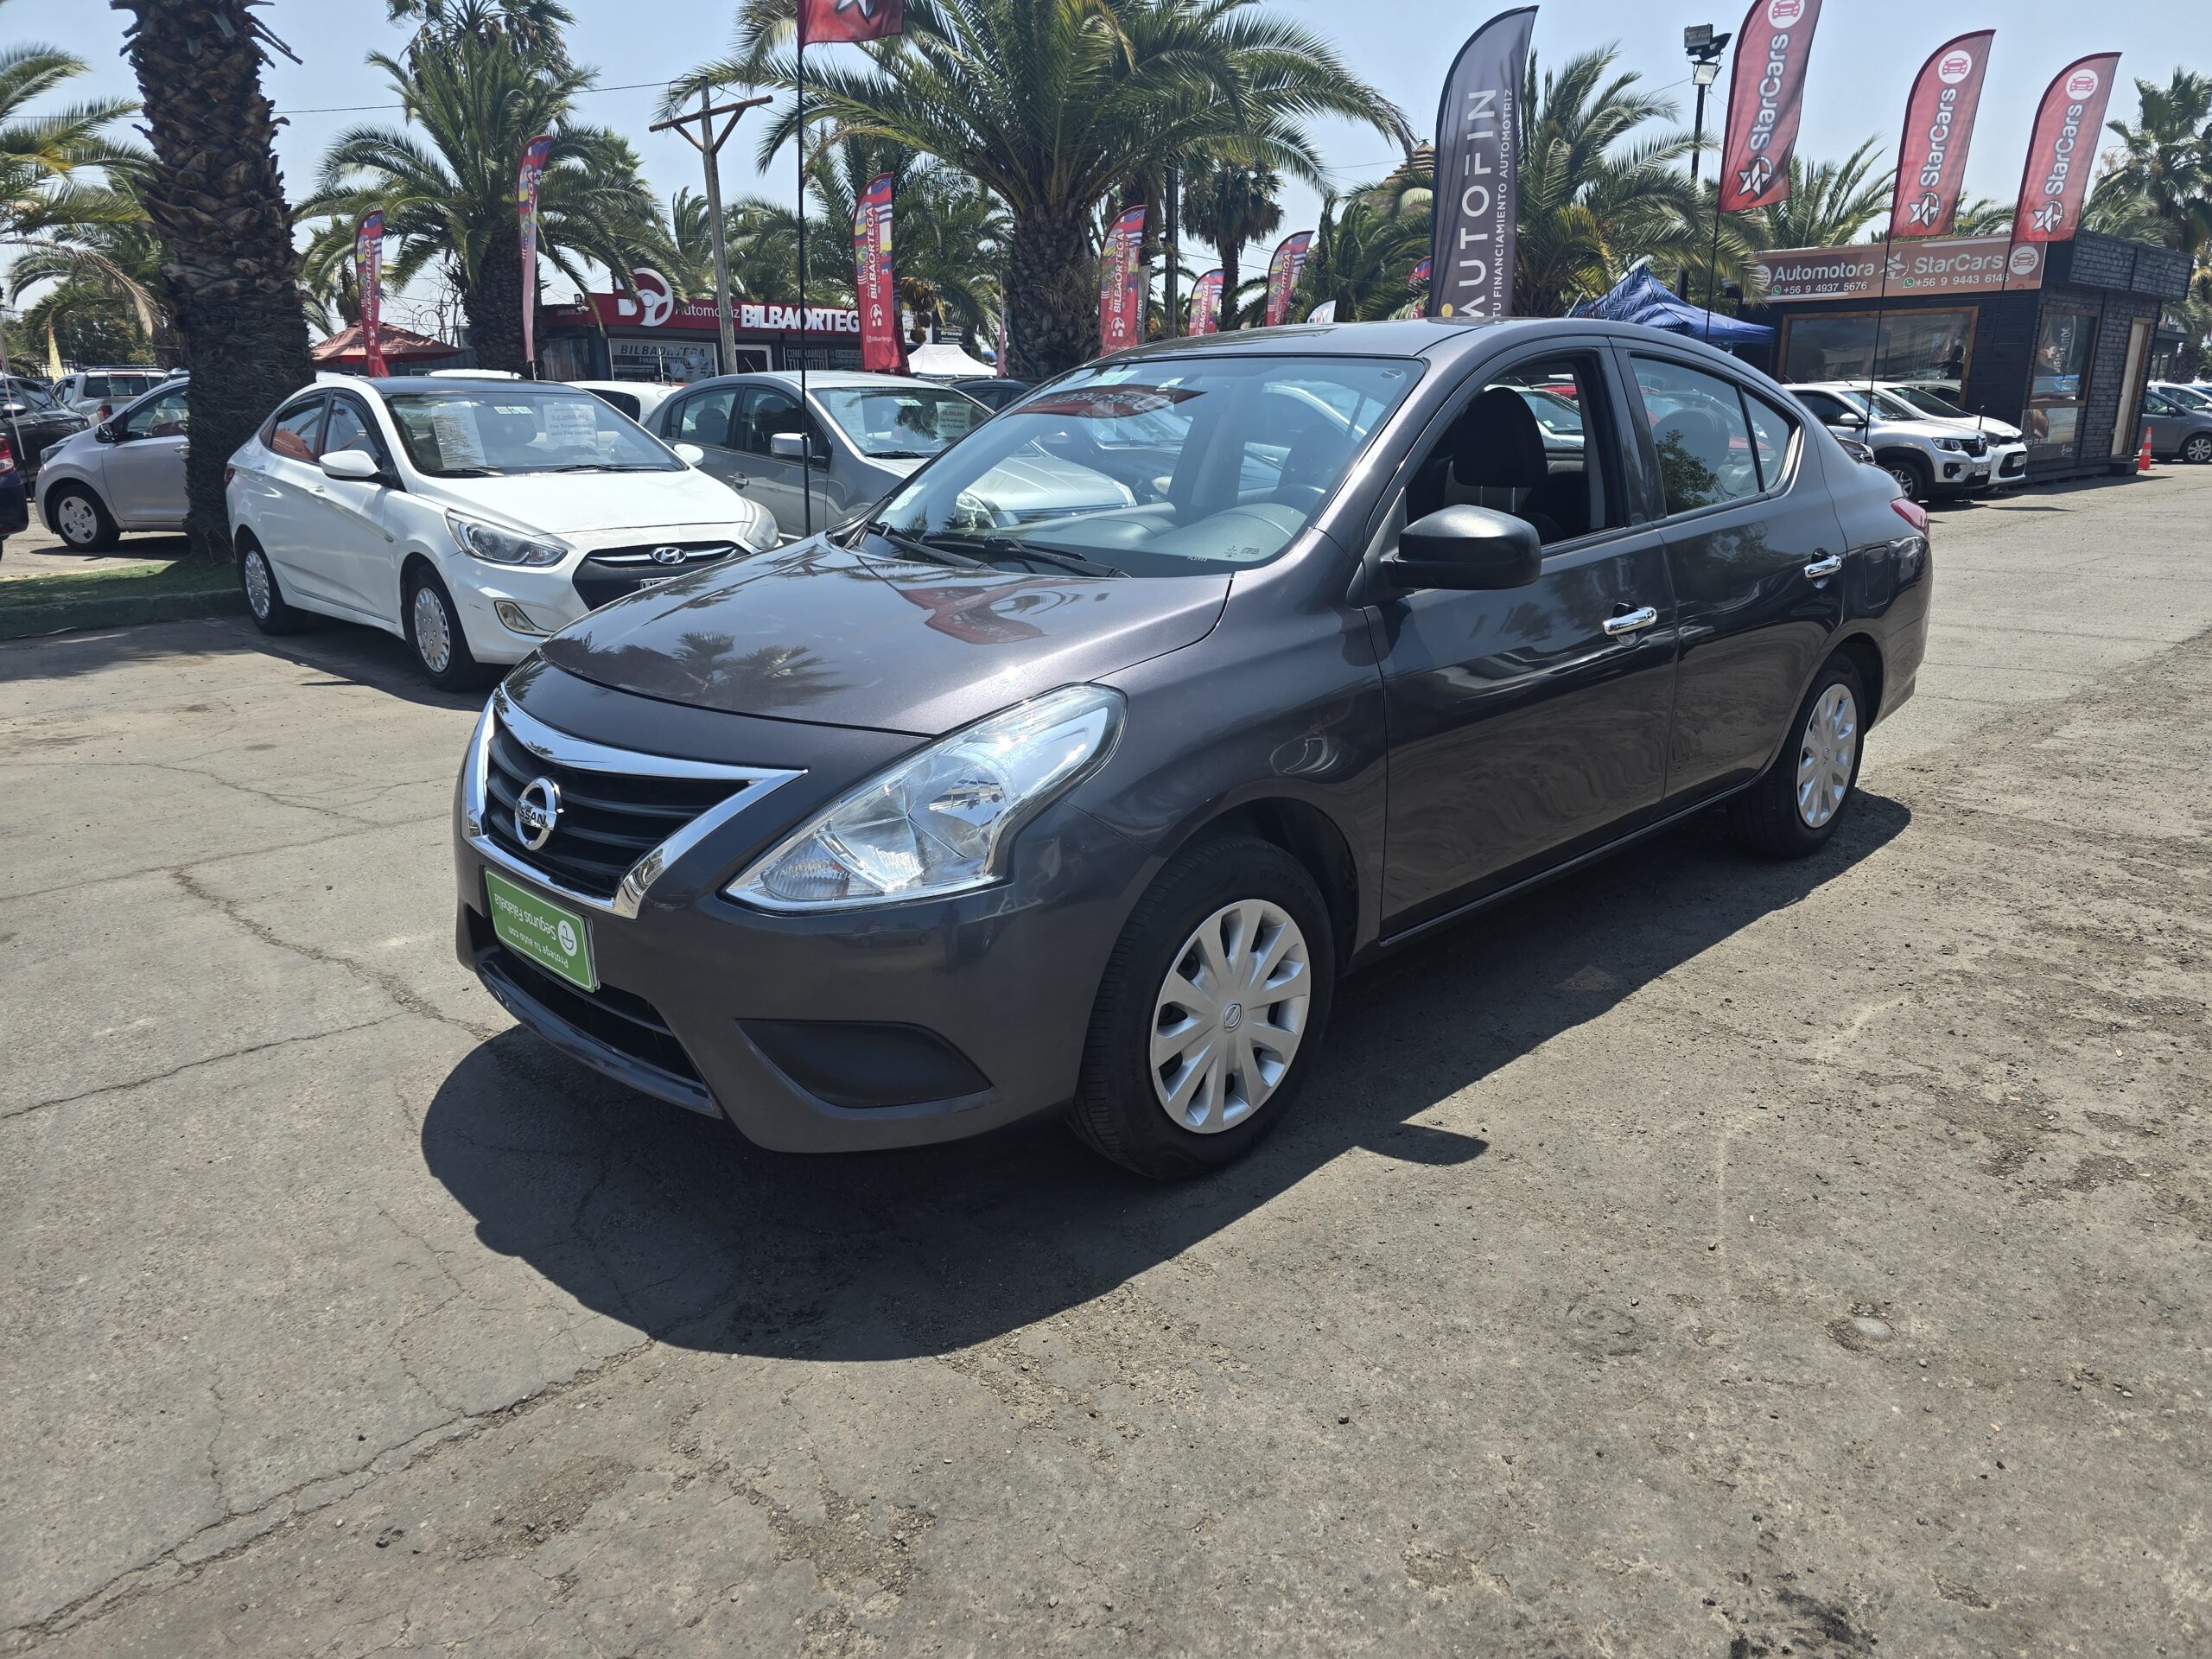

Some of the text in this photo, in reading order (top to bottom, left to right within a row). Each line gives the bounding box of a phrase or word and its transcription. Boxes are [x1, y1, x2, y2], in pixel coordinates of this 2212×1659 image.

[1750, 33, 1789, 150] StarCars
[1920, 87, 1956, 188] StarCars
[2045, 103, 2082, 196] StarCars
[1459, 89, 1497, 317] AUTOFIN
[1492, 88, 1513, 317] TU FINANCIAMIENTO AUTOMOTRIZ
[866, 207, 878, 299] BILBAORTEGA
[1113, 232, 1125, 313] BILBAORTEGA
[1773, 262, 1874, 283] Automotora
[1783, 282, 1867, 295] +56 9 4937 5676
[1914, 253, 2004, 275] StarCars
[1916, 277, 1936, 287] +56
[1941, 276, 1947, 286] 9
[1953, 275, 1980, 285] 9443
[494, 893, 556, 941] Seguros Falabella
[507, 925, 569, 969] Protege tu auto con
